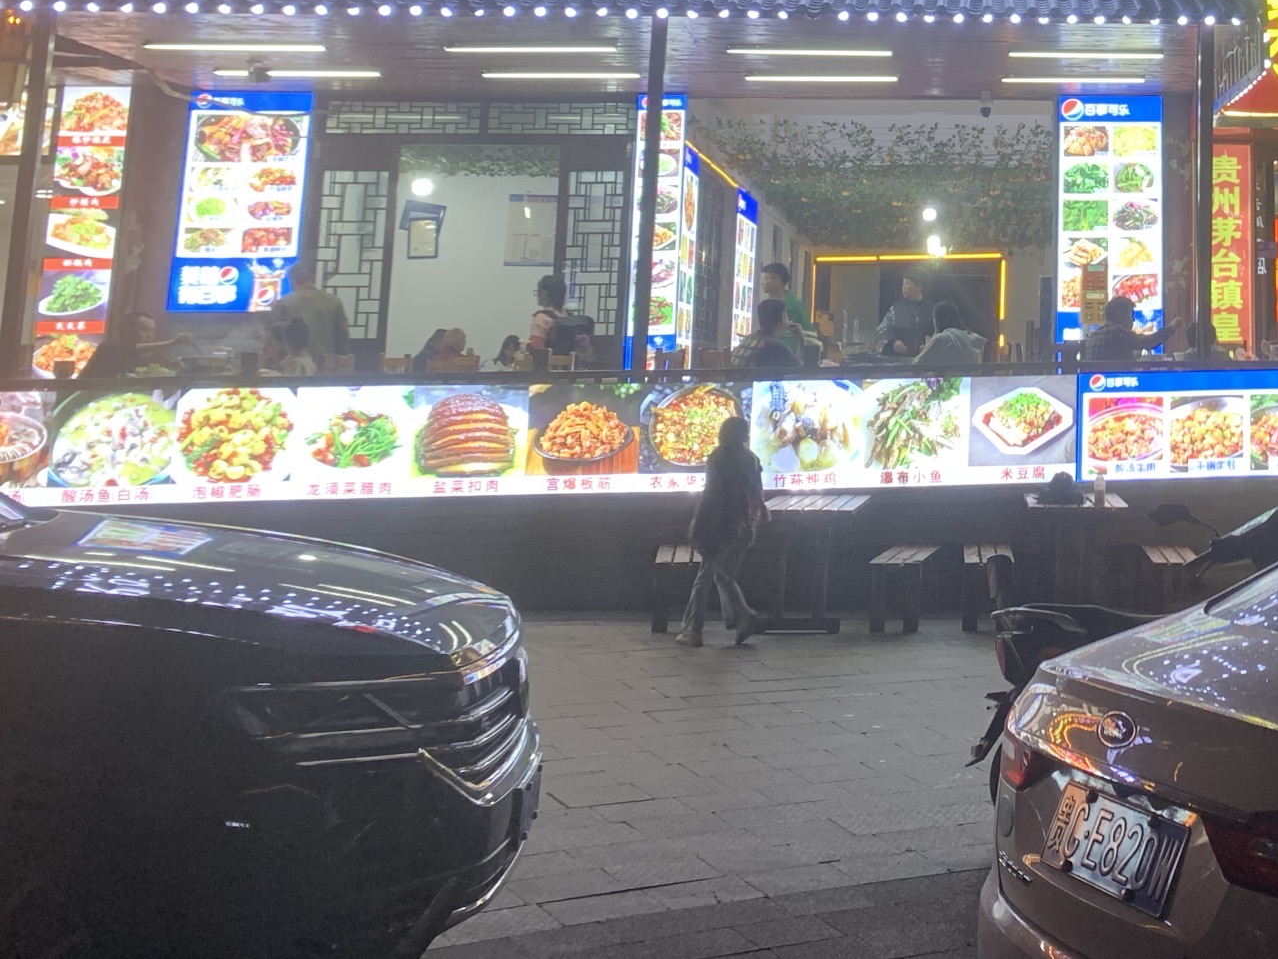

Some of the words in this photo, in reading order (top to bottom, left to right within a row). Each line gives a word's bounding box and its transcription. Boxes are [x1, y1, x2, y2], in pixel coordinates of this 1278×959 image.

[880, 471, 942, 484] 瀑布小鱼
[1001, 466, 1046, 480] 米豆腐
[192, 485, 262, 499] 泡椒肥肠
[307, 482, 392, 496] 龙须菜腊肉
[433, 480, 499, 493] 盐菜扣肉
